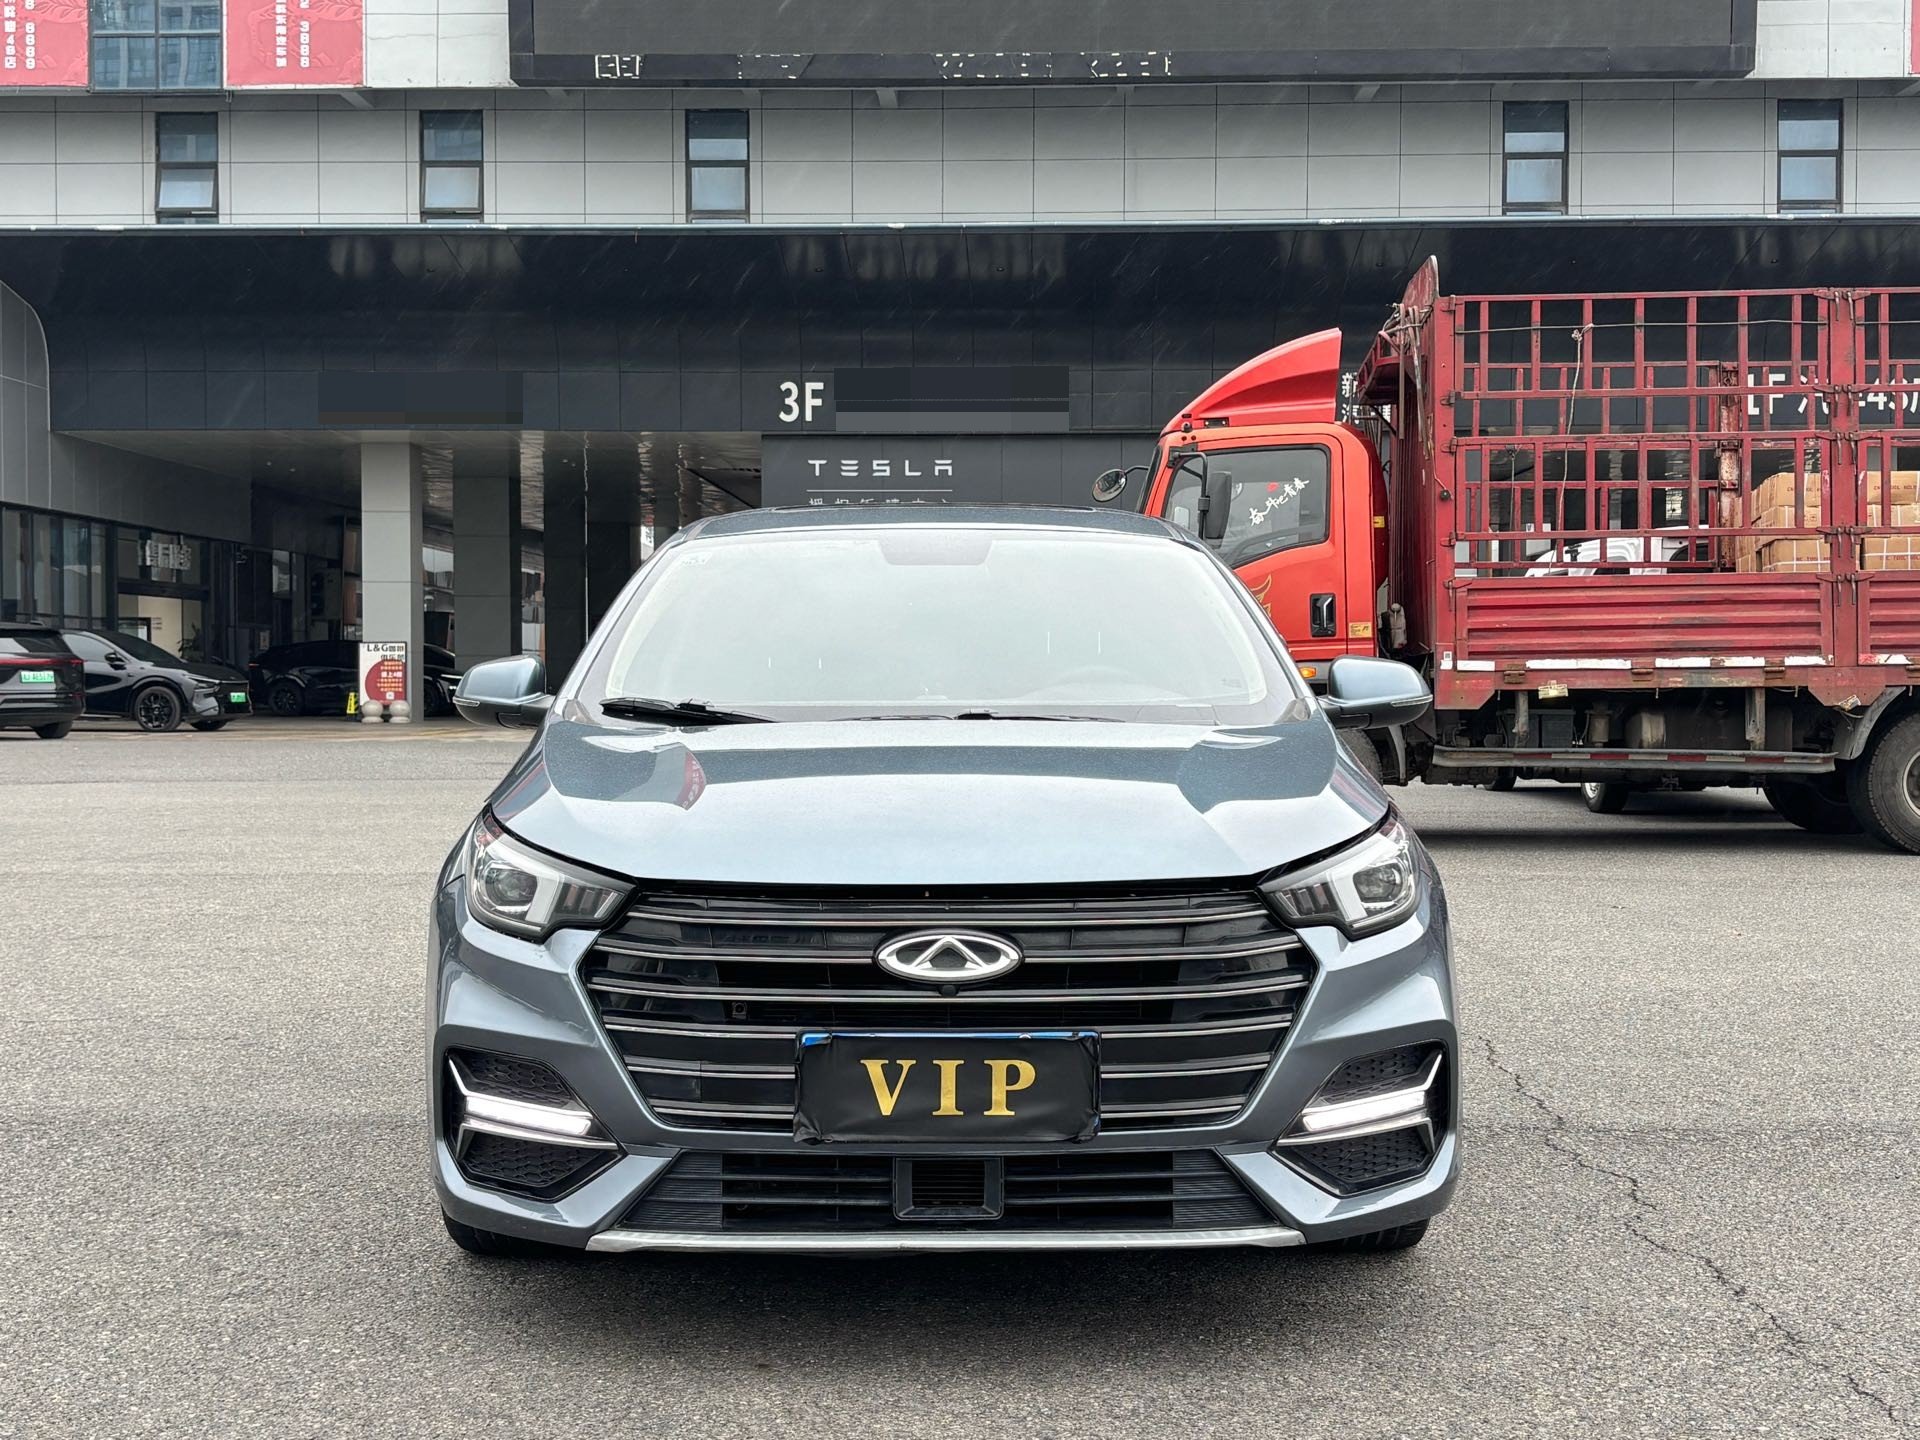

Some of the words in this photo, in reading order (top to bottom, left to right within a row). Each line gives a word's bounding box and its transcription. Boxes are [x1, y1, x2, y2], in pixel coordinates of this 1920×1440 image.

[778, 381, 824, 422] 3F
[807, 459, 953, 476] TESLA
[859, 1058, 1037, 1116] VIP
